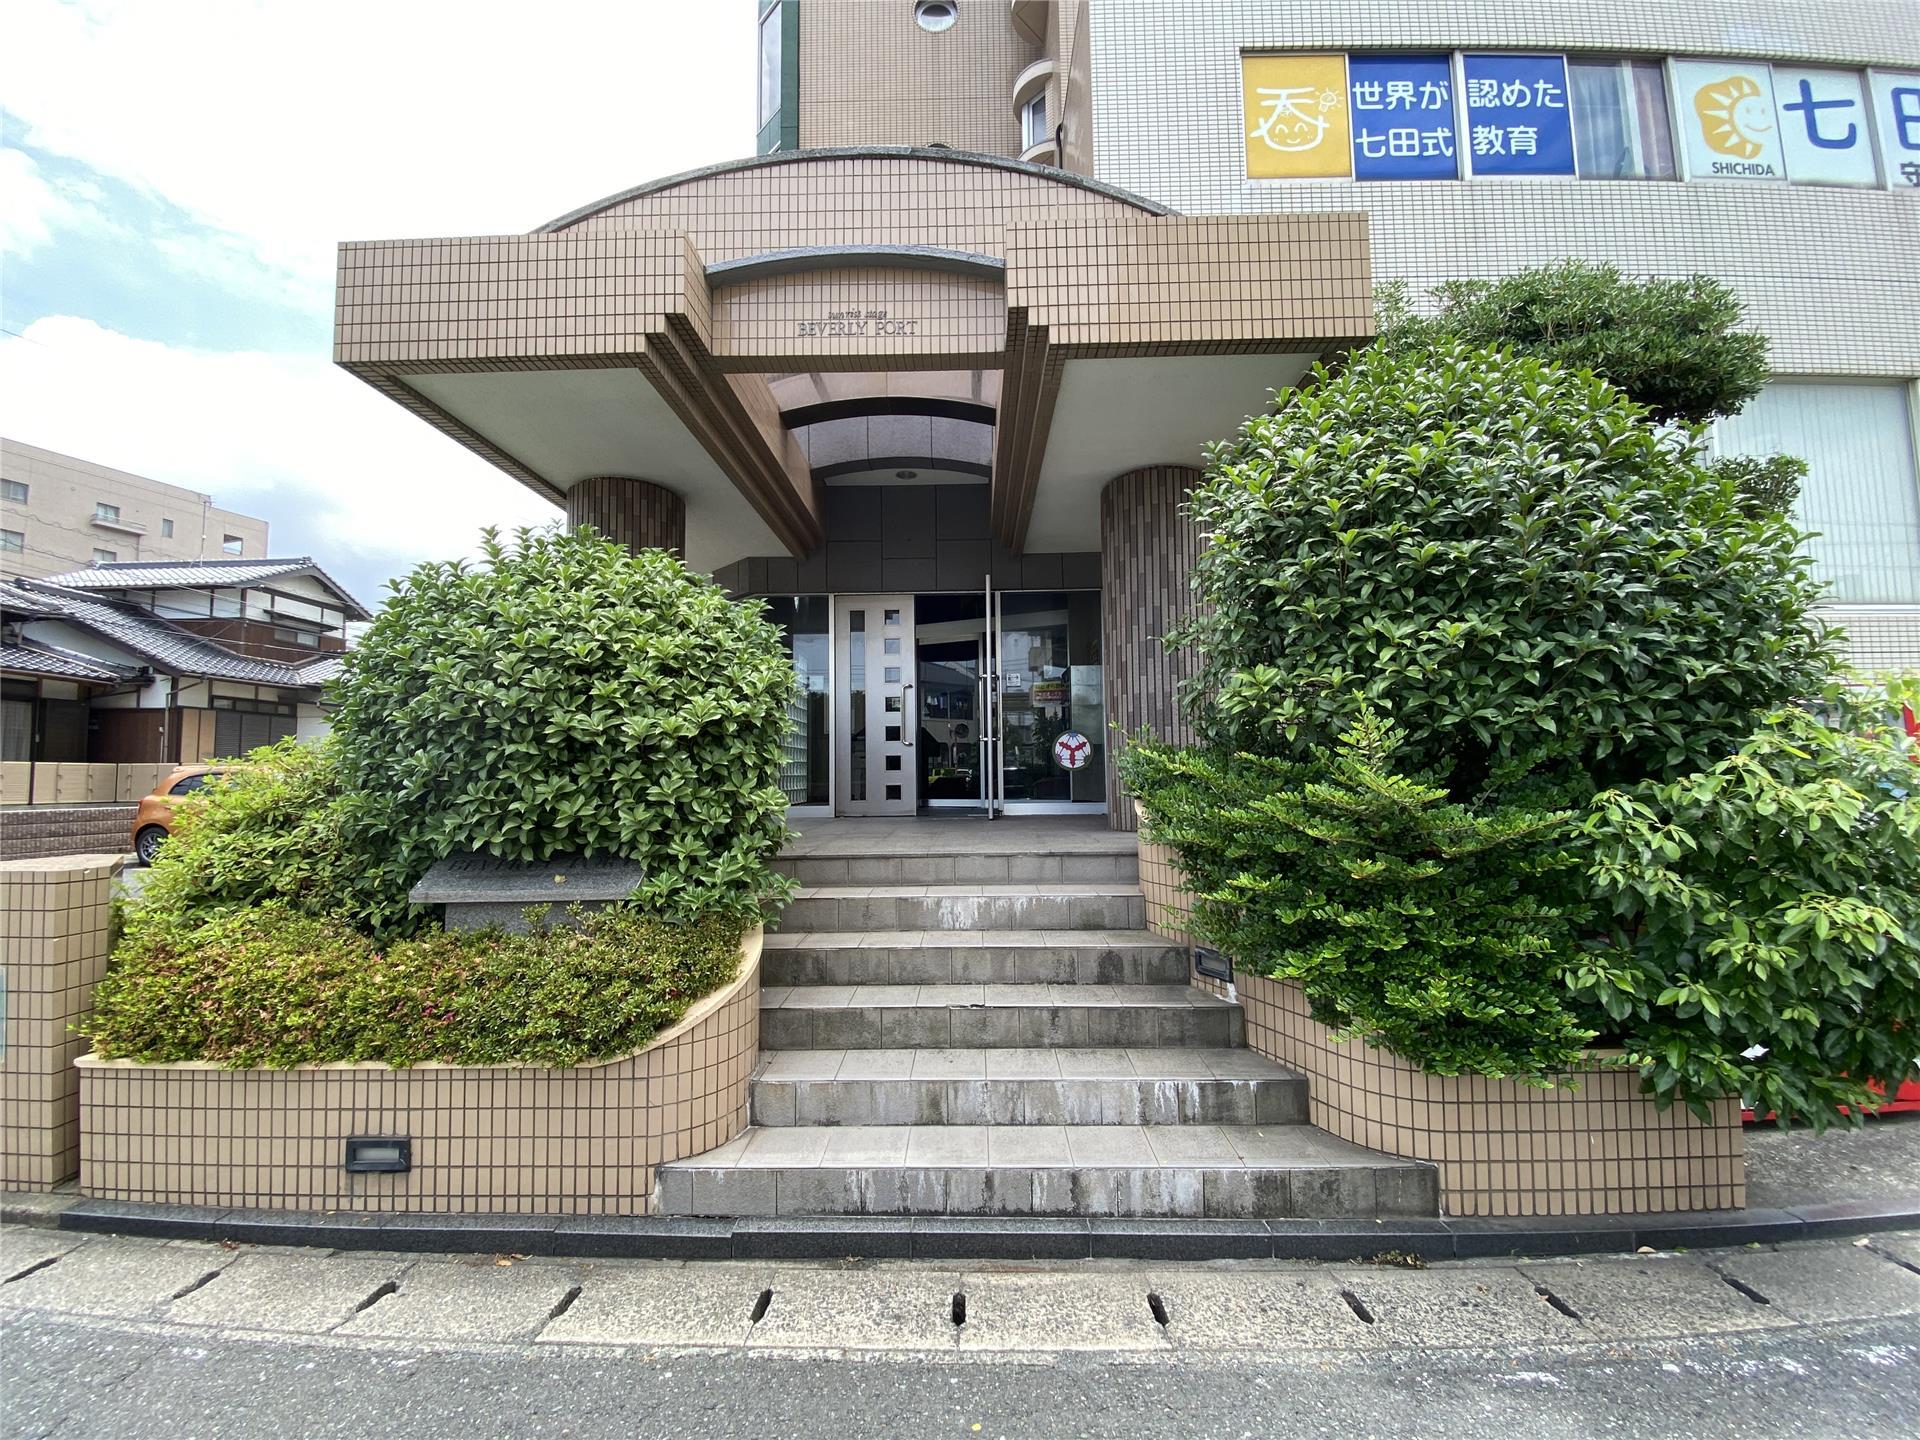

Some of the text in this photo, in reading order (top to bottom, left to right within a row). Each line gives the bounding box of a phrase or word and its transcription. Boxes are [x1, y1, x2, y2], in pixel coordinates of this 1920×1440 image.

[1352, 79, 1565, 110] 世界が 認めた
[1355, 124, 1538, 158] 七田式 教育
[1712, 161, 1775, 176] SHICHIDA
[798, 320, 918, 336] BEVERLY PORT
